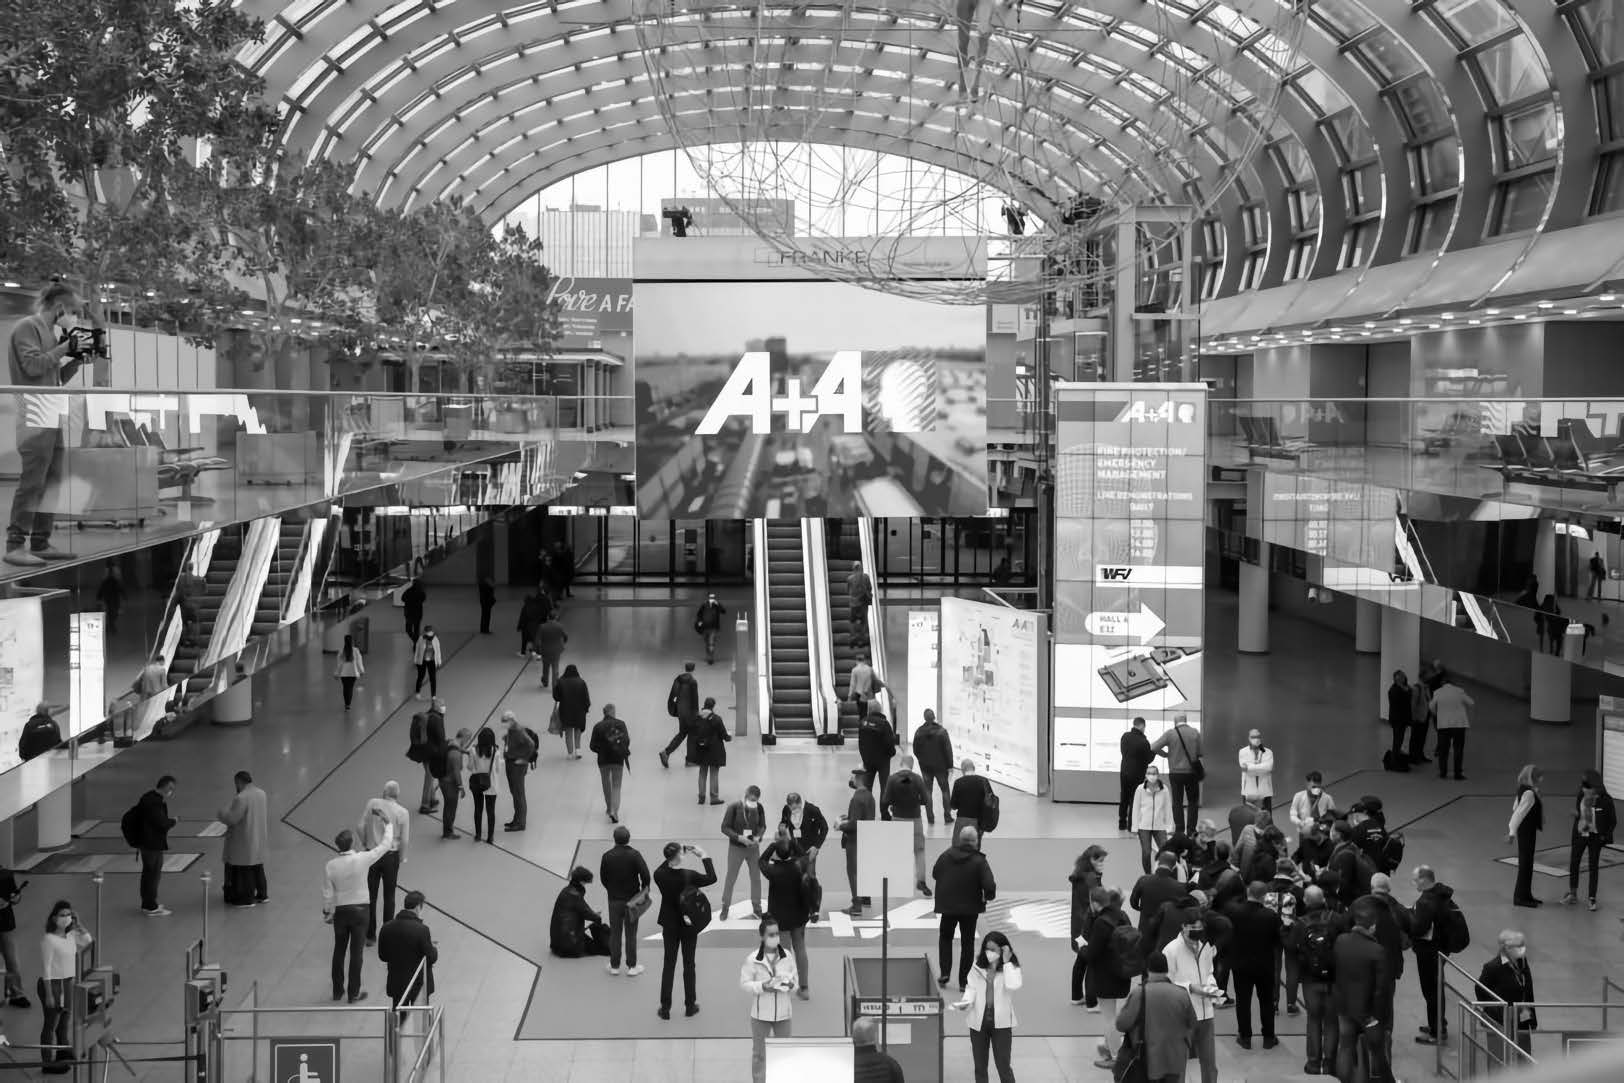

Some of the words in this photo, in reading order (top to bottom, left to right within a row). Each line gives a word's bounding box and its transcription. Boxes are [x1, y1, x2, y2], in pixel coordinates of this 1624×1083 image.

[598, 294, 612, 312] A
[694, 350, 863, 435] A+A
[1121, 400, 1174, 424] A+A
